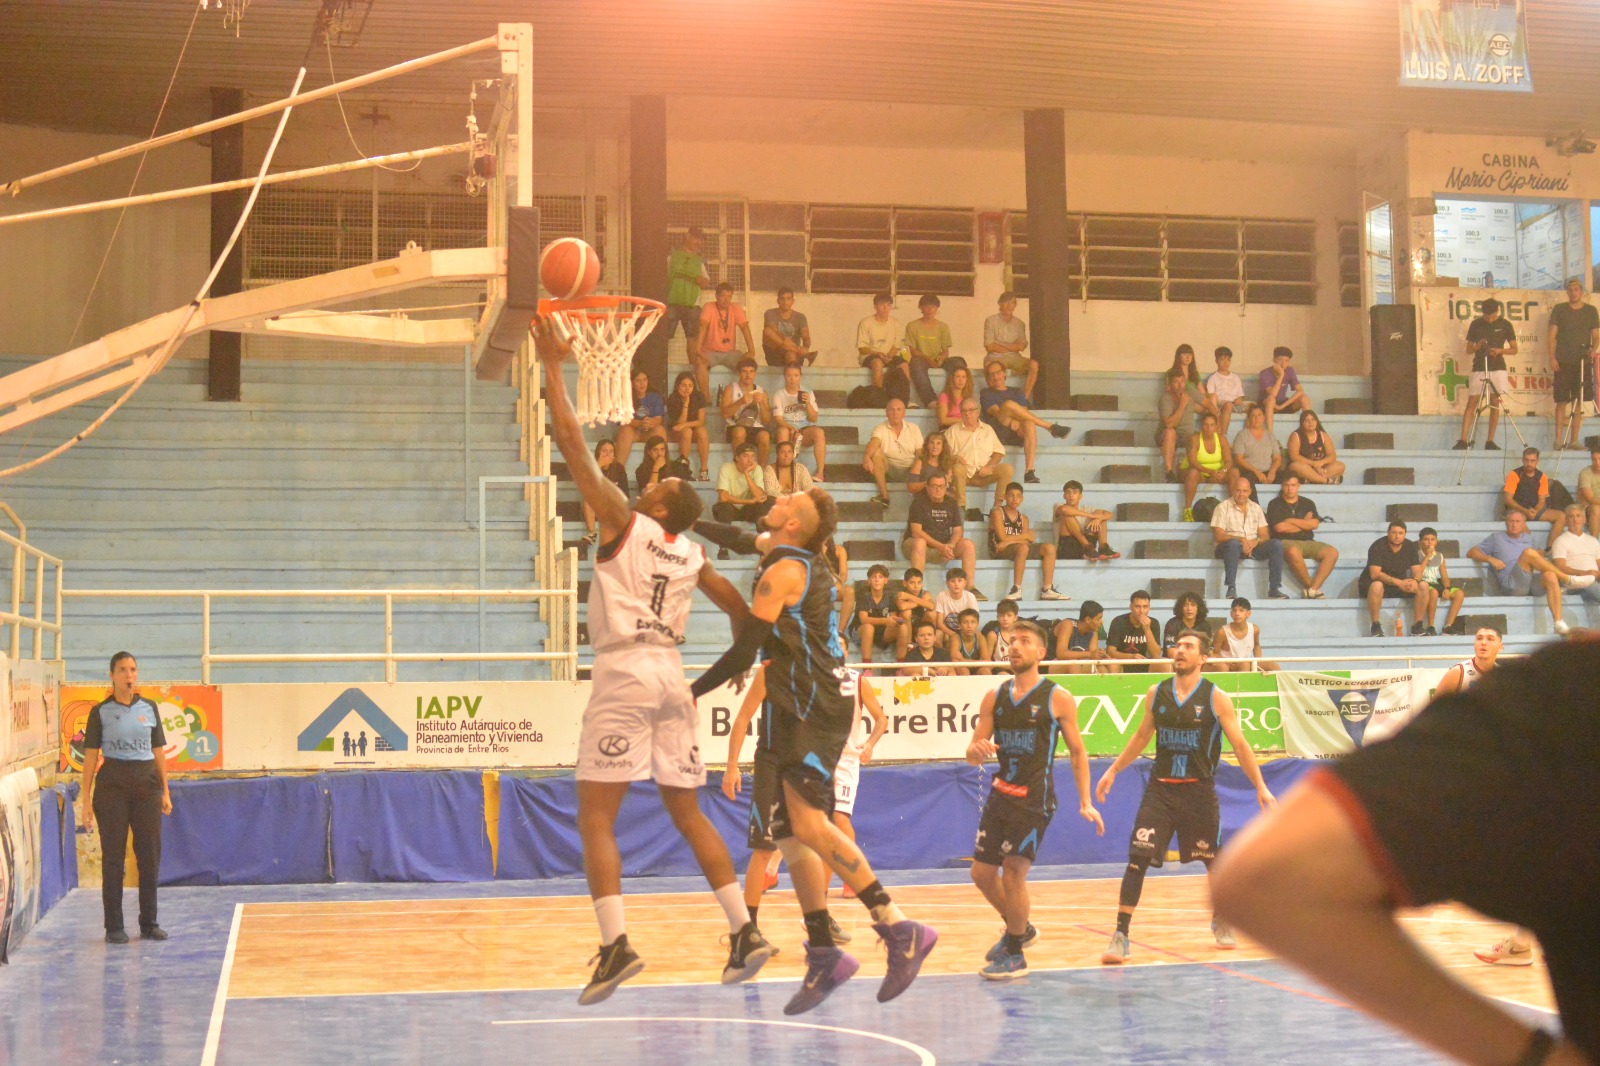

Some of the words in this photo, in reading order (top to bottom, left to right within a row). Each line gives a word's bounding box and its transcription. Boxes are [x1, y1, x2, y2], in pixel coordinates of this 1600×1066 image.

[1489, 41, 1512, 50] AEC
[1405, 60, 1448, 81] LUIS
[1453, 63, 1471, 82] A.
[1476, 64, 1524, 84] ZOFF
[1482, 153, 1540, 169] CABINA
[1445, 167, 1496, 190] Mario
[1498, 169, 1572, 194] Cipriani
[1298, 677, 1342, 686] ATLETICO
[1390, 674, 1413, 685] CLUB
[416, 695, 483, 719] IAPV
[1340, 703, 1371, 714] AEC
[416, 720, 457, 731] Instituto
[460, 718, 516, 732] Autárquico
[518, 719, 532, 731] de
[416, 731, 486, 743] Planeamiento
[489, 733, 496, 746] y
[497, 731, 543, 743] Vivienda
[416, 745, 452, 754] Provincia
[454, 745, 464, 753] de
[468, 744, 489, 753] Entre
